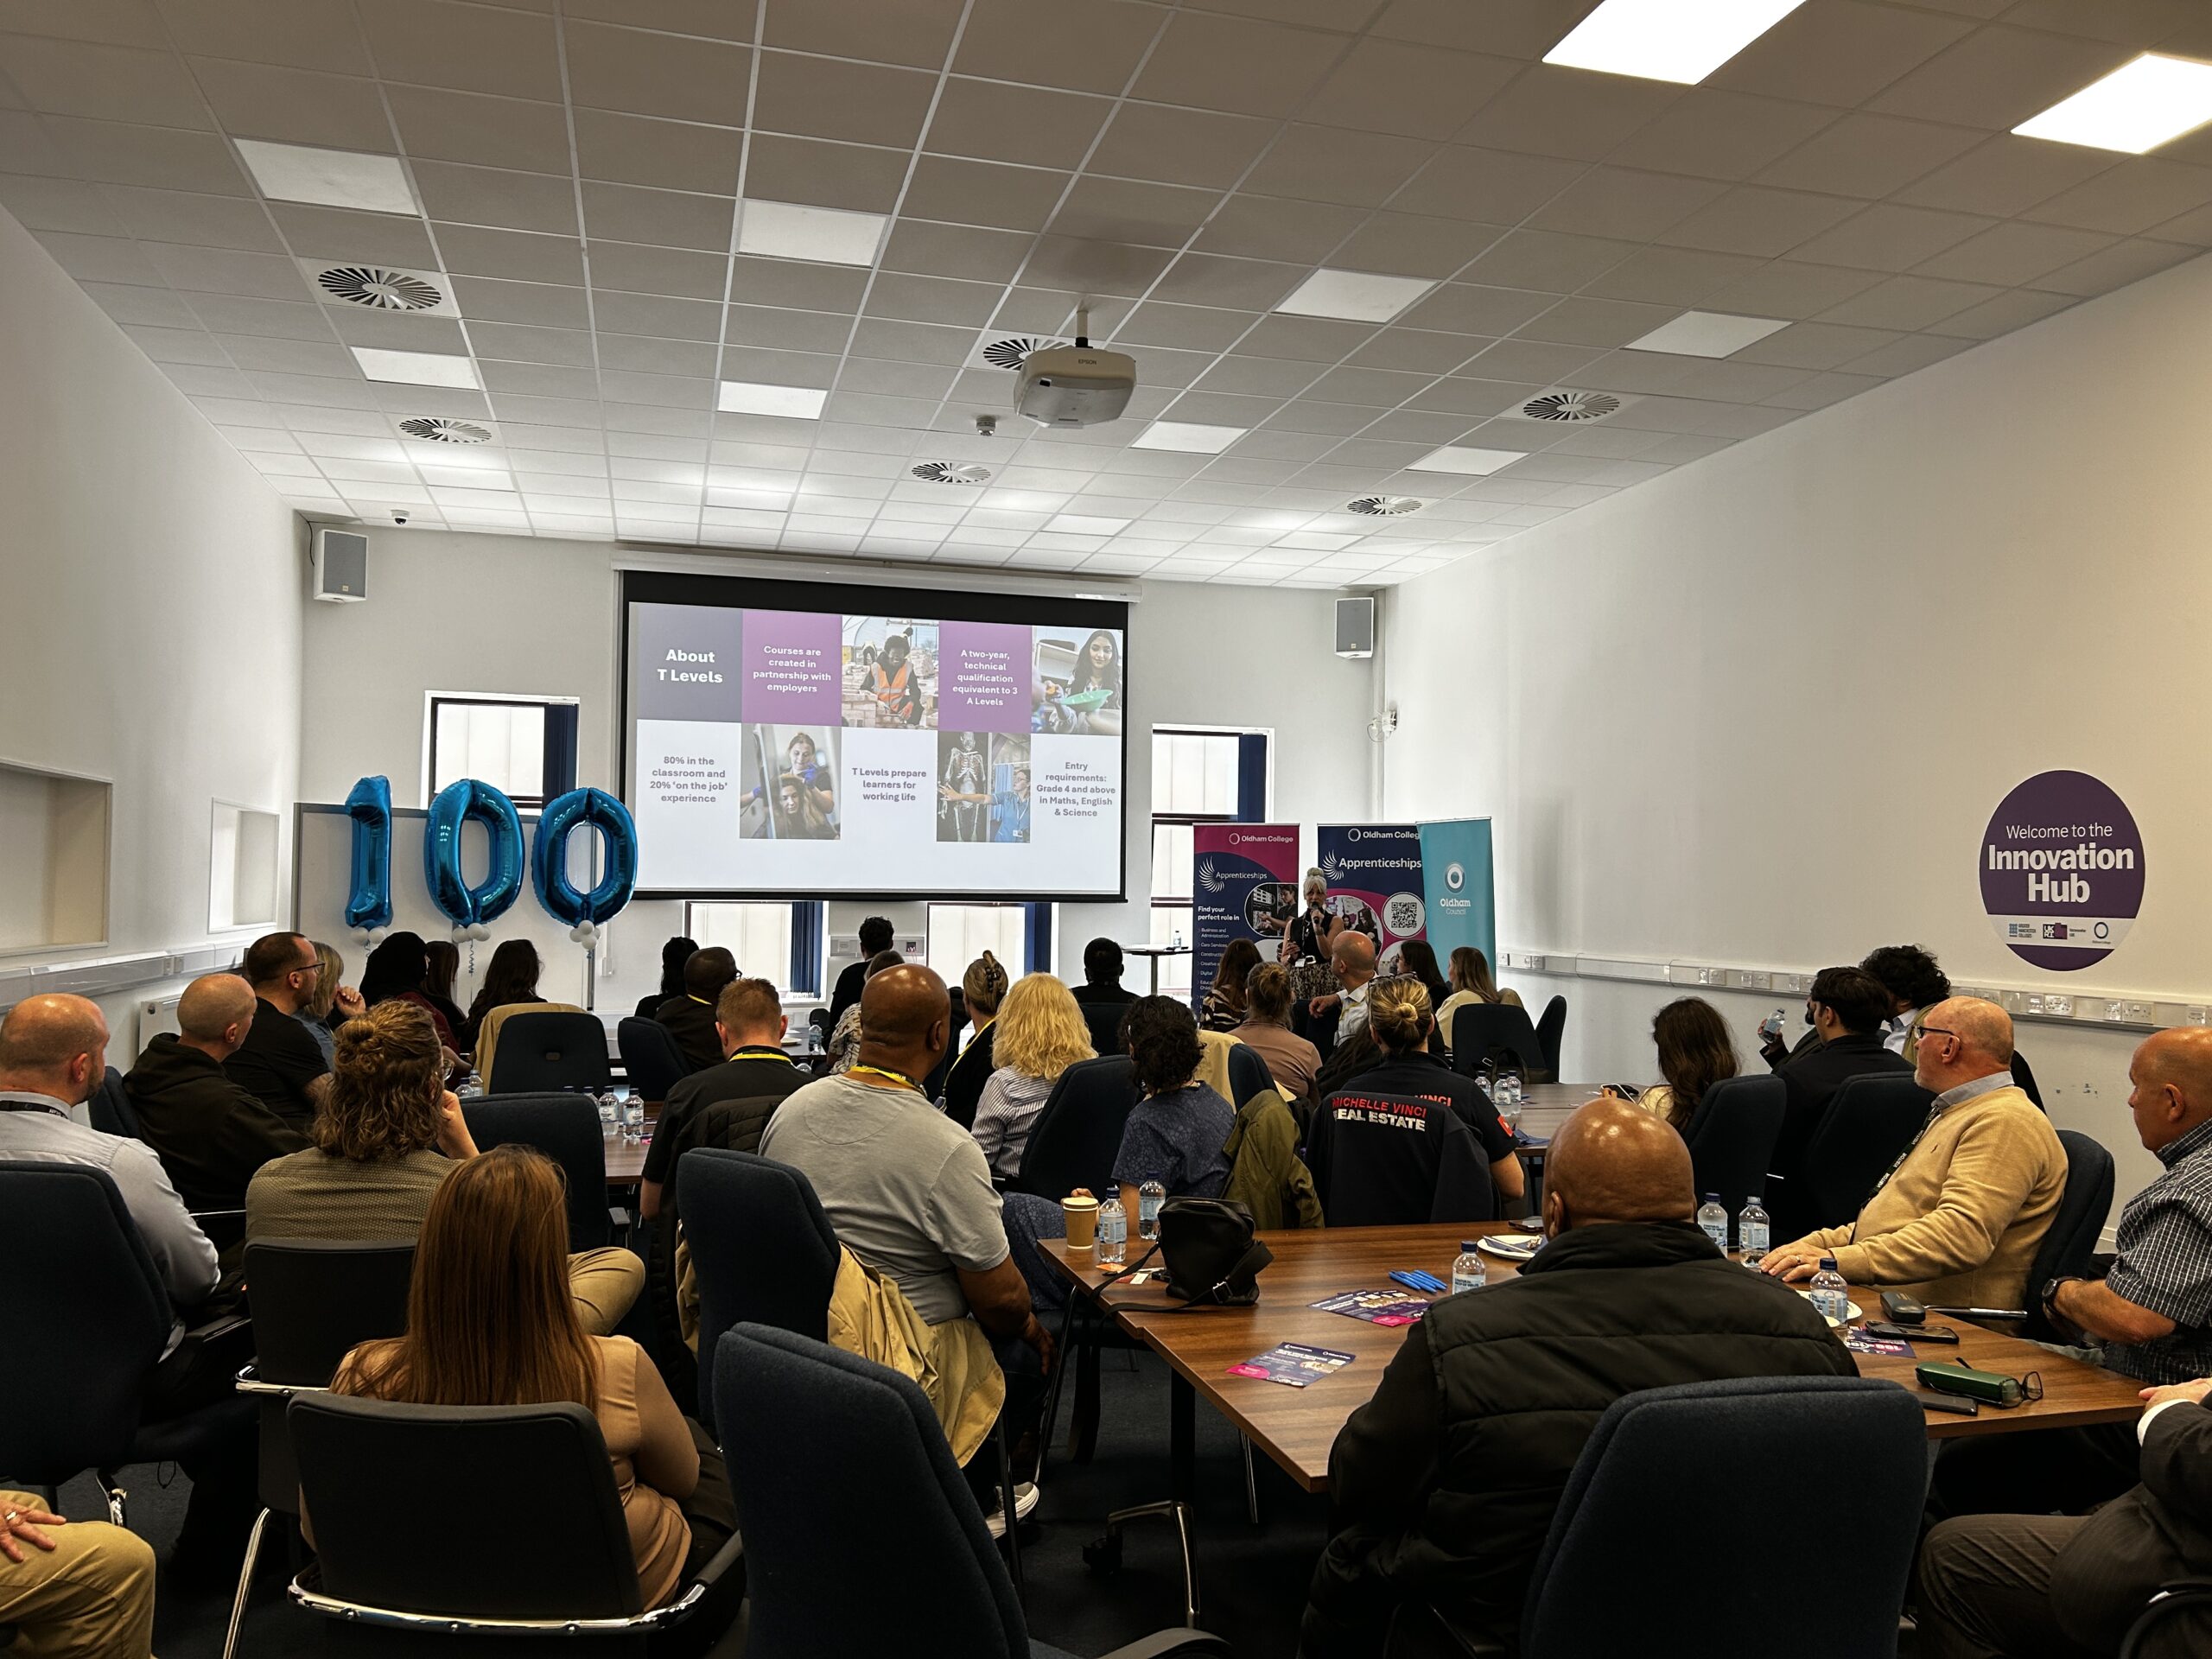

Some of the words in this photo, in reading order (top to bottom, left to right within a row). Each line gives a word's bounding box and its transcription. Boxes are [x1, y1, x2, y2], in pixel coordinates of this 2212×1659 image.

[665, 649, 715, 663] About
[764, 645, 804, 656] Courses
[969, 650, 1010, 660] two-year,
[768, 658, 805, 668] created
[807, 659, 817, 668] in
[964, 662, 1007, 671] technical
[658, 669, 667, 681] T
[671, 669, 723, 683] Levels
[753, 671, 809, 682] partnership
[810, 672, 831, 681] with
[957, 673, 1014, 683] qualification
[766, 683, 817, 693] employers
[952, 685, 1001, 695] equivalent
[975, 697, 1003, 706] Levels
[664, 756, 685, 765] 80%
[687, 756, 696, 766] in
[698, 757, 715, 766] the
[1065, 762, 1088, 771] Entry
[652, 768, 705, 778] classroom
[707, 770, 726, 779] and
[852, 767, 858, 776] T
[859, 768, 889, 777] Levels
[891, 770, 927, 779] prepare
[1046, 773, 1107, 782] requirements:
[650, 781, 671, 790] 20%
[690, 782, 708, 791] the
[862, 779, 900, 789] learners
[902, 780, 916, 789] for
[1037, 785, 1063, 793] Grade
[1090, 785, 1116, 794] above
[661, 794, 716, 804] experience
[862, 792, 899, 803] working
[900, 792, 916, 802] life
[1039, 796, 1048, 804] in
[1049, 797, 1079, 806] Maths,
[1081, 797, 1113, 807] English
[1395, 831, 1420, 841] Colleg
[2005, 824, 2069, 839] Welcome
[2071, 824, 2086, 837] to
[2088, 823, 2113, 837] the
[345, 774, 639, 929] 100
[1988, 842, 2134, 870] Innovation
[1338, 857, 1422, 871] Apprenticeships
[2028, 873, 2090, 903] Hub
[1440, 899, 1471, 907] Oldham
[1332, 1097, 1389, 1111] MICHELLE
[1393, 1103, 1427, 1118] VINCI
[1369, 1111, 1426, 1132] ESTATE
[1893, 1153, 1907, 1167] VISITOR
[1877, 1173, 1890, 1187] VISITOR
